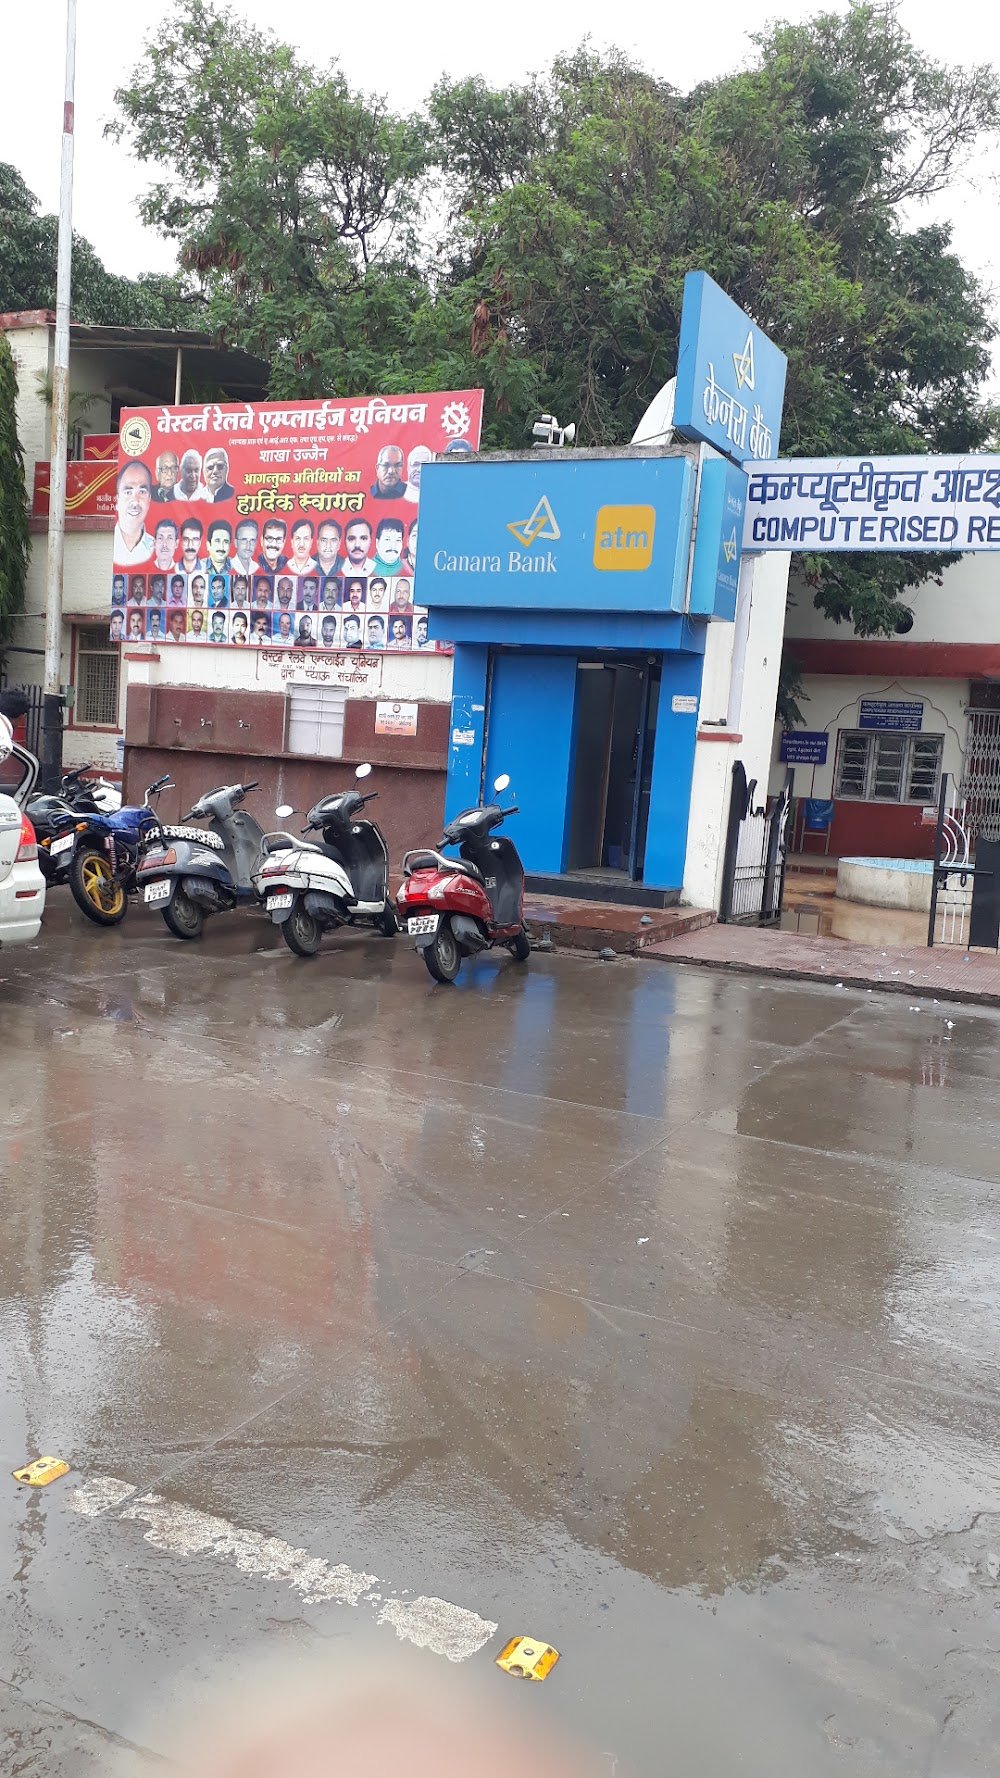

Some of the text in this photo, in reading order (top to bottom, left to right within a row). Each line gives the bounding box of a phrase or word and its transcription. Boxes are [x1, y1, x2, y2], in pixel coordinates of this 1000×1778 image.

[157, 397, 428, 434] वेस्टर्न रेलवे एम्प्लाईज यूनियन
[703, 362, 772, 460] केनरा बैंक
[259, 443, 328, 462] शाखा उज्जैन
[243, 467, 361, 488] आगन्तुक अतिथियों का
[749, 462, 928, 514] कम्प्यूटरीकृत
[236, 487, 365, 514] हार्दिक स्वागत
[600, 527, 648, 548] atm
[752, 516, 1000, 543] COMPUTERISED RE
[433, 550, 558, 573] Canara Bank
